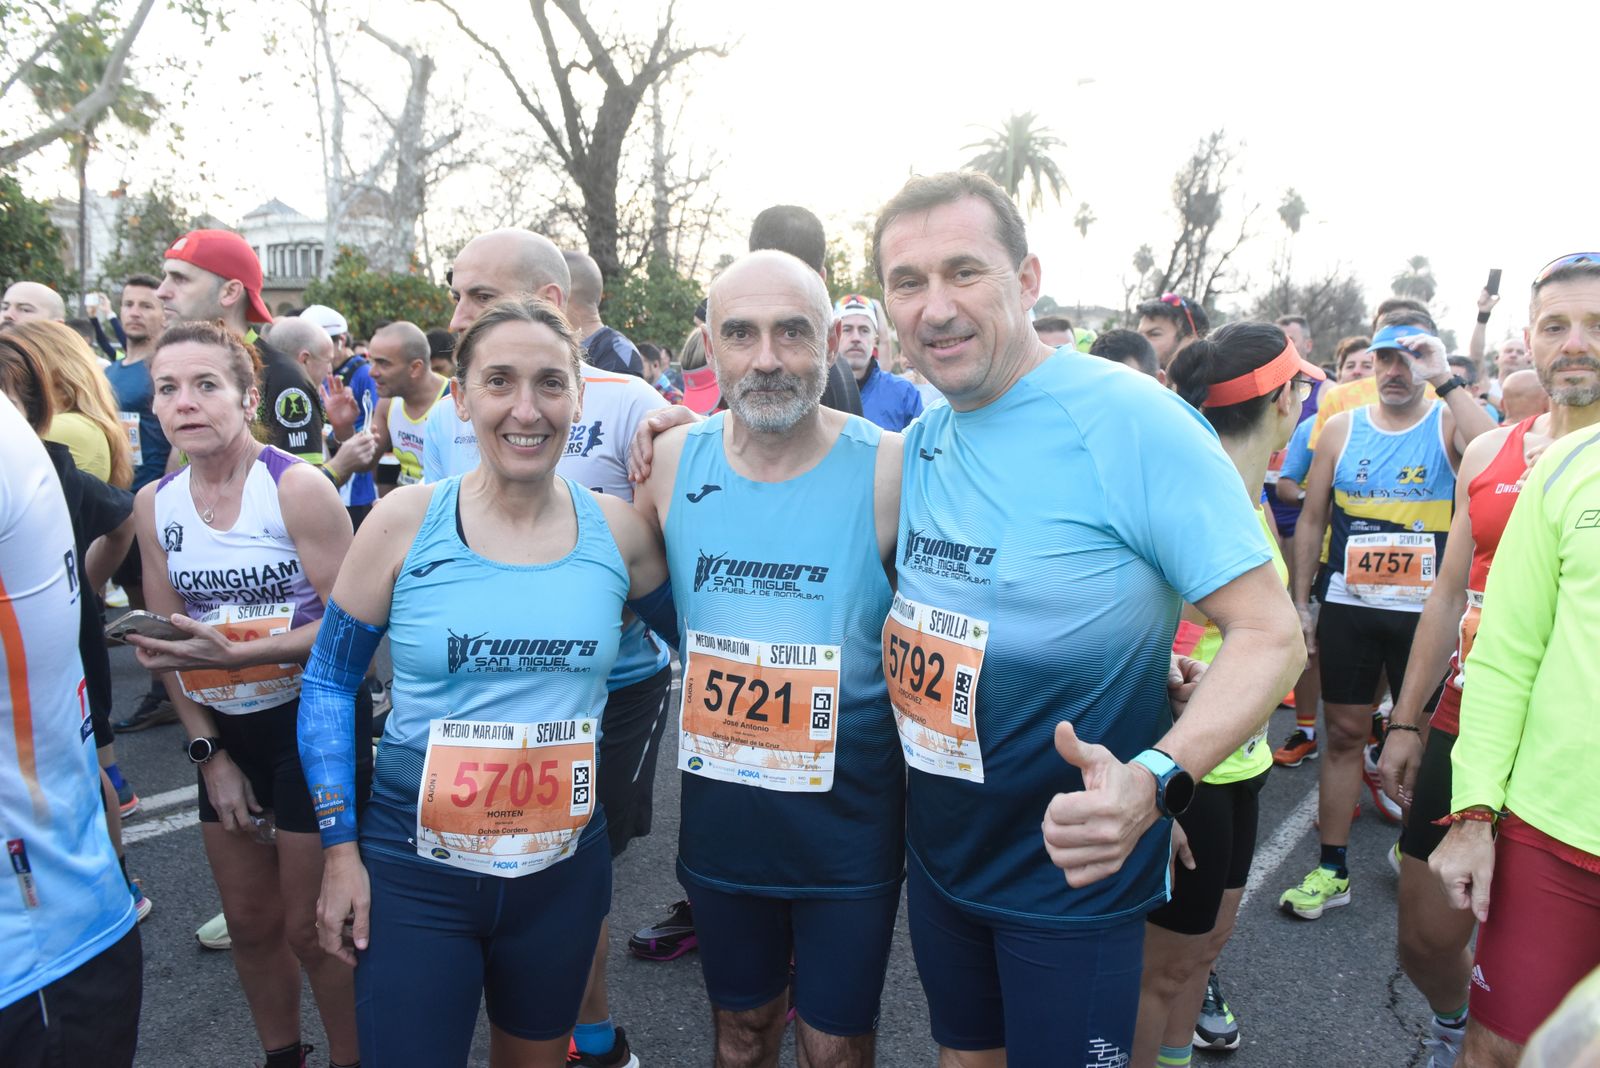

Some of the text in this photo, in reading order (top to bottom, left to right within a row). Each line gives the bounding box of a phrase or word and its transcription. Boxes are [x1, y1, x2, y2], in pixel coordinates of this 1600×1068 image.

[914, 554, 970, 575] SAN MIGUEL
[1358, 551, 1414, 574] 4757
[169, 559, 299, 591] UCKINGHAM
[713, 576, 801, 592] SAN MIGUEL
[721, 587, 756, 595] PUEBLA
[773, 591, 824, 601] MONTALBAN
[237, 605, 275, 620] SEVILLA
[929, 609, 968, 640] SEVILLA
[695, 633, 817, 666] MEDIO MARATÓN SEVILLA
[474, 656, 570, 667] SAN MIGUEL
[889, 632, 945, 702] 5792
[703, 669, 792, 725] 5721
[442, 721, 576, 744] MEDIO MARATÓN SEVILLA
[740, 722, 770, 733] Antonio
[450, 760, 560, 808] 5705
[737, 768, 760, 779] HOKA
[486, 810, 524, 819] HORTEN
[492, 861, 518, 870] HOKA
